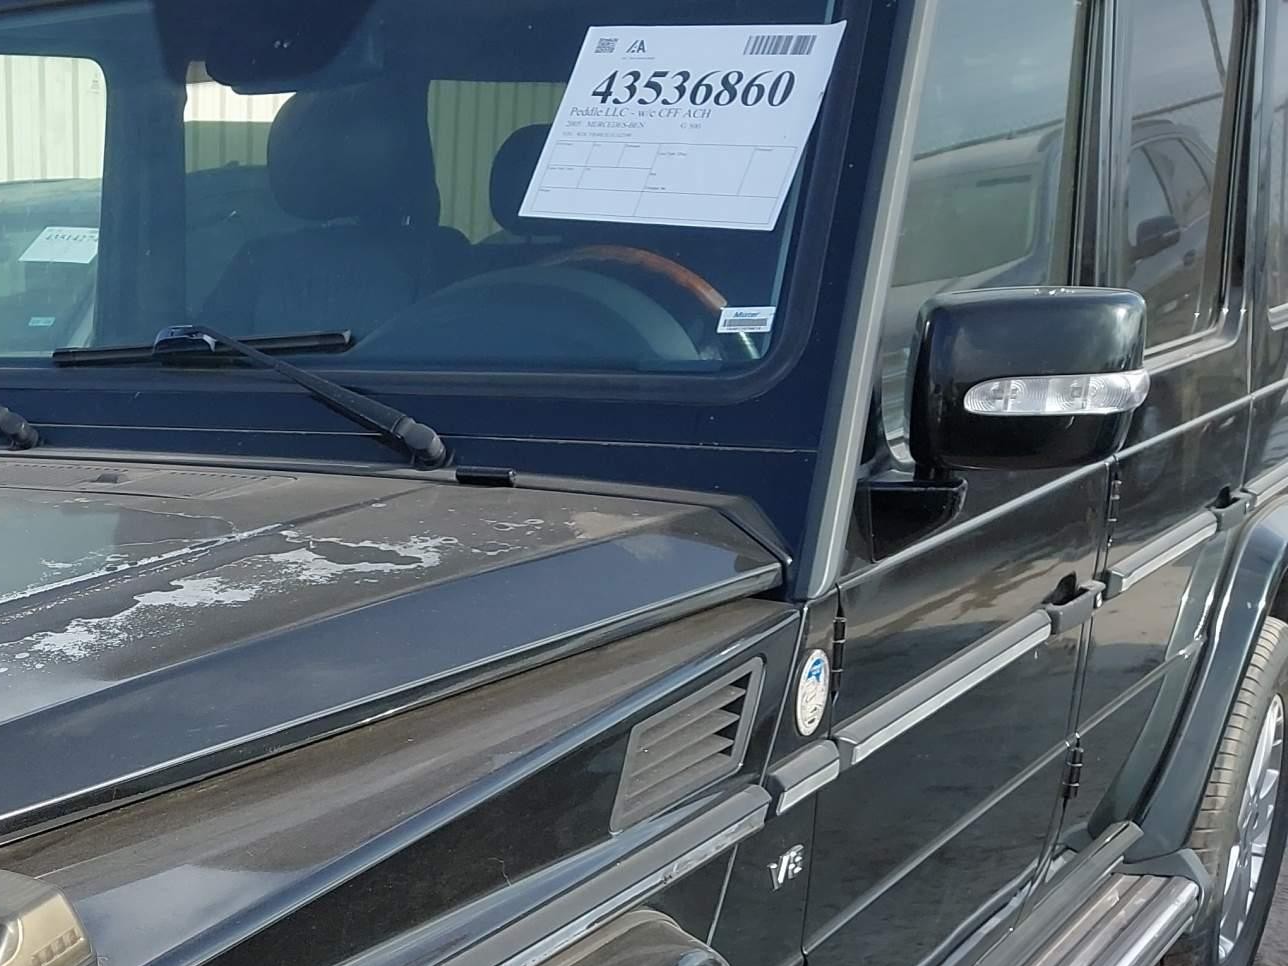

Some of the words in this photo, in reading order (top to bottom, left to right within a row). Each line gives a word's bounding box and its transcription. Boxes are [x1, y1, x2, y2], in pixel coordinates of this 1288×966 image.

[591, 69, 795, 107] 43536860
[569, 106, 604, 117] Peddle
[603, 107, 629, 118] LLC
[682, 108, 712, 119] ACH
